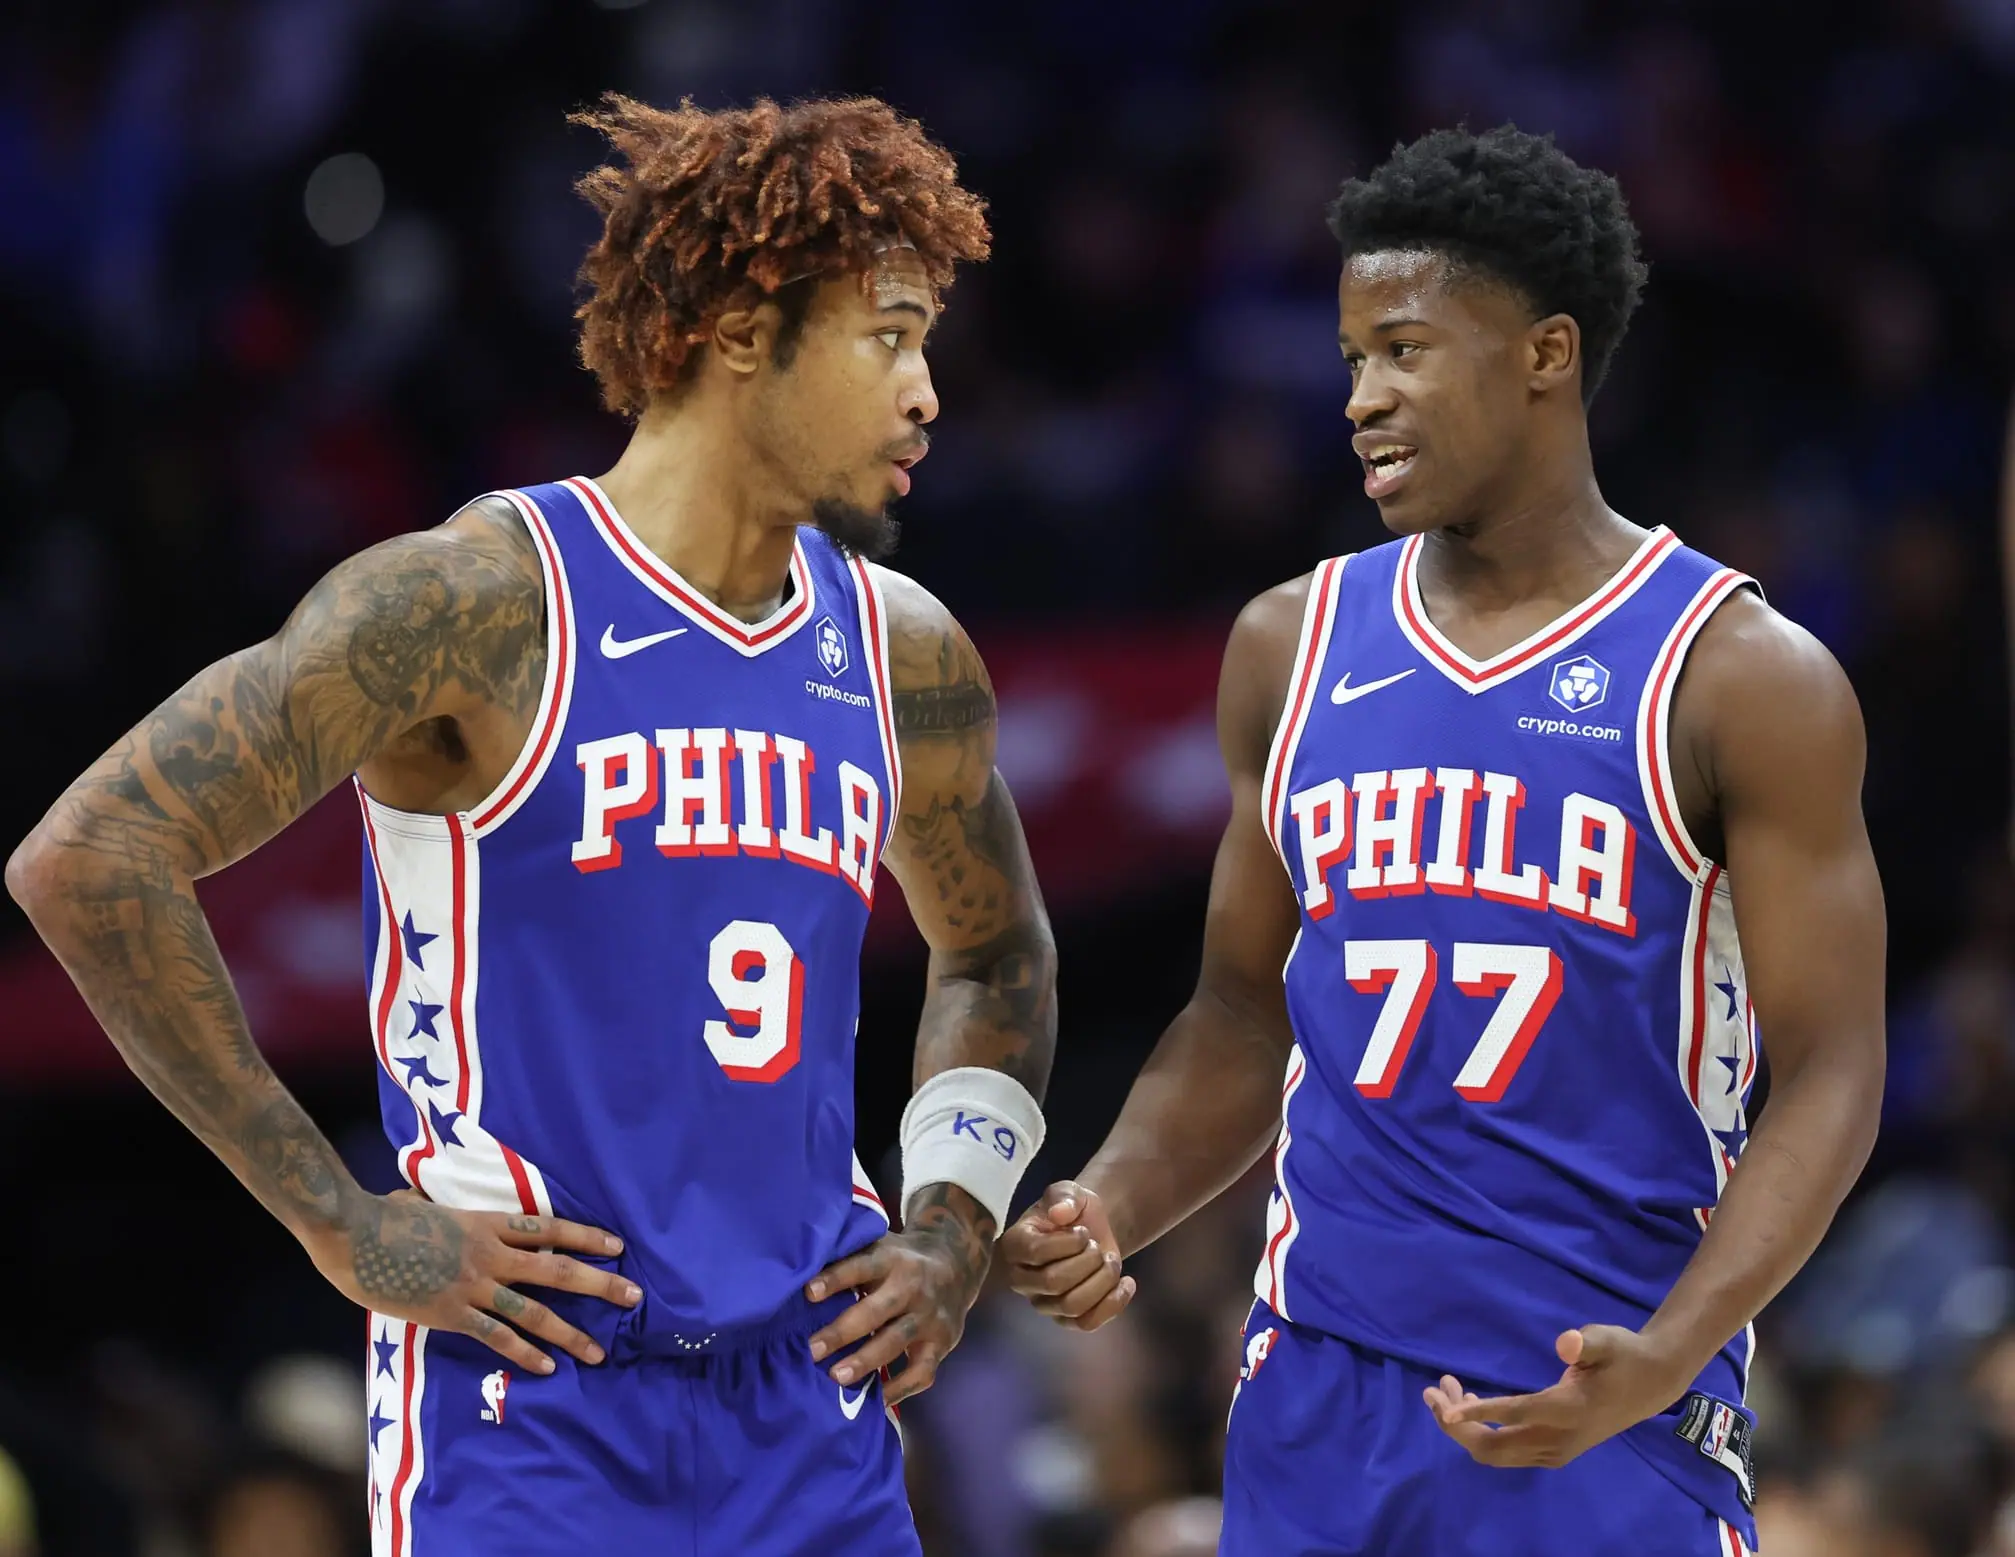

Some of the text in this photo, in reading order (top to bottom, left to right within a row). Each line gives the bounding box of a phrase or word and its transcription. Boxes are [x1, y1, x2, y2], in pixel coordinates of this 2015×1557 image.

[805, 679, 871, 708] crypto.com
[1517, 714, 1622, 742] crypto.com
[571, 728, 884, 912] PHILA
[1290, 767, 1637, 938] PHILA
[703, 920, 804, 1083] 9
[1344, 939, 1563, 1103] 77
